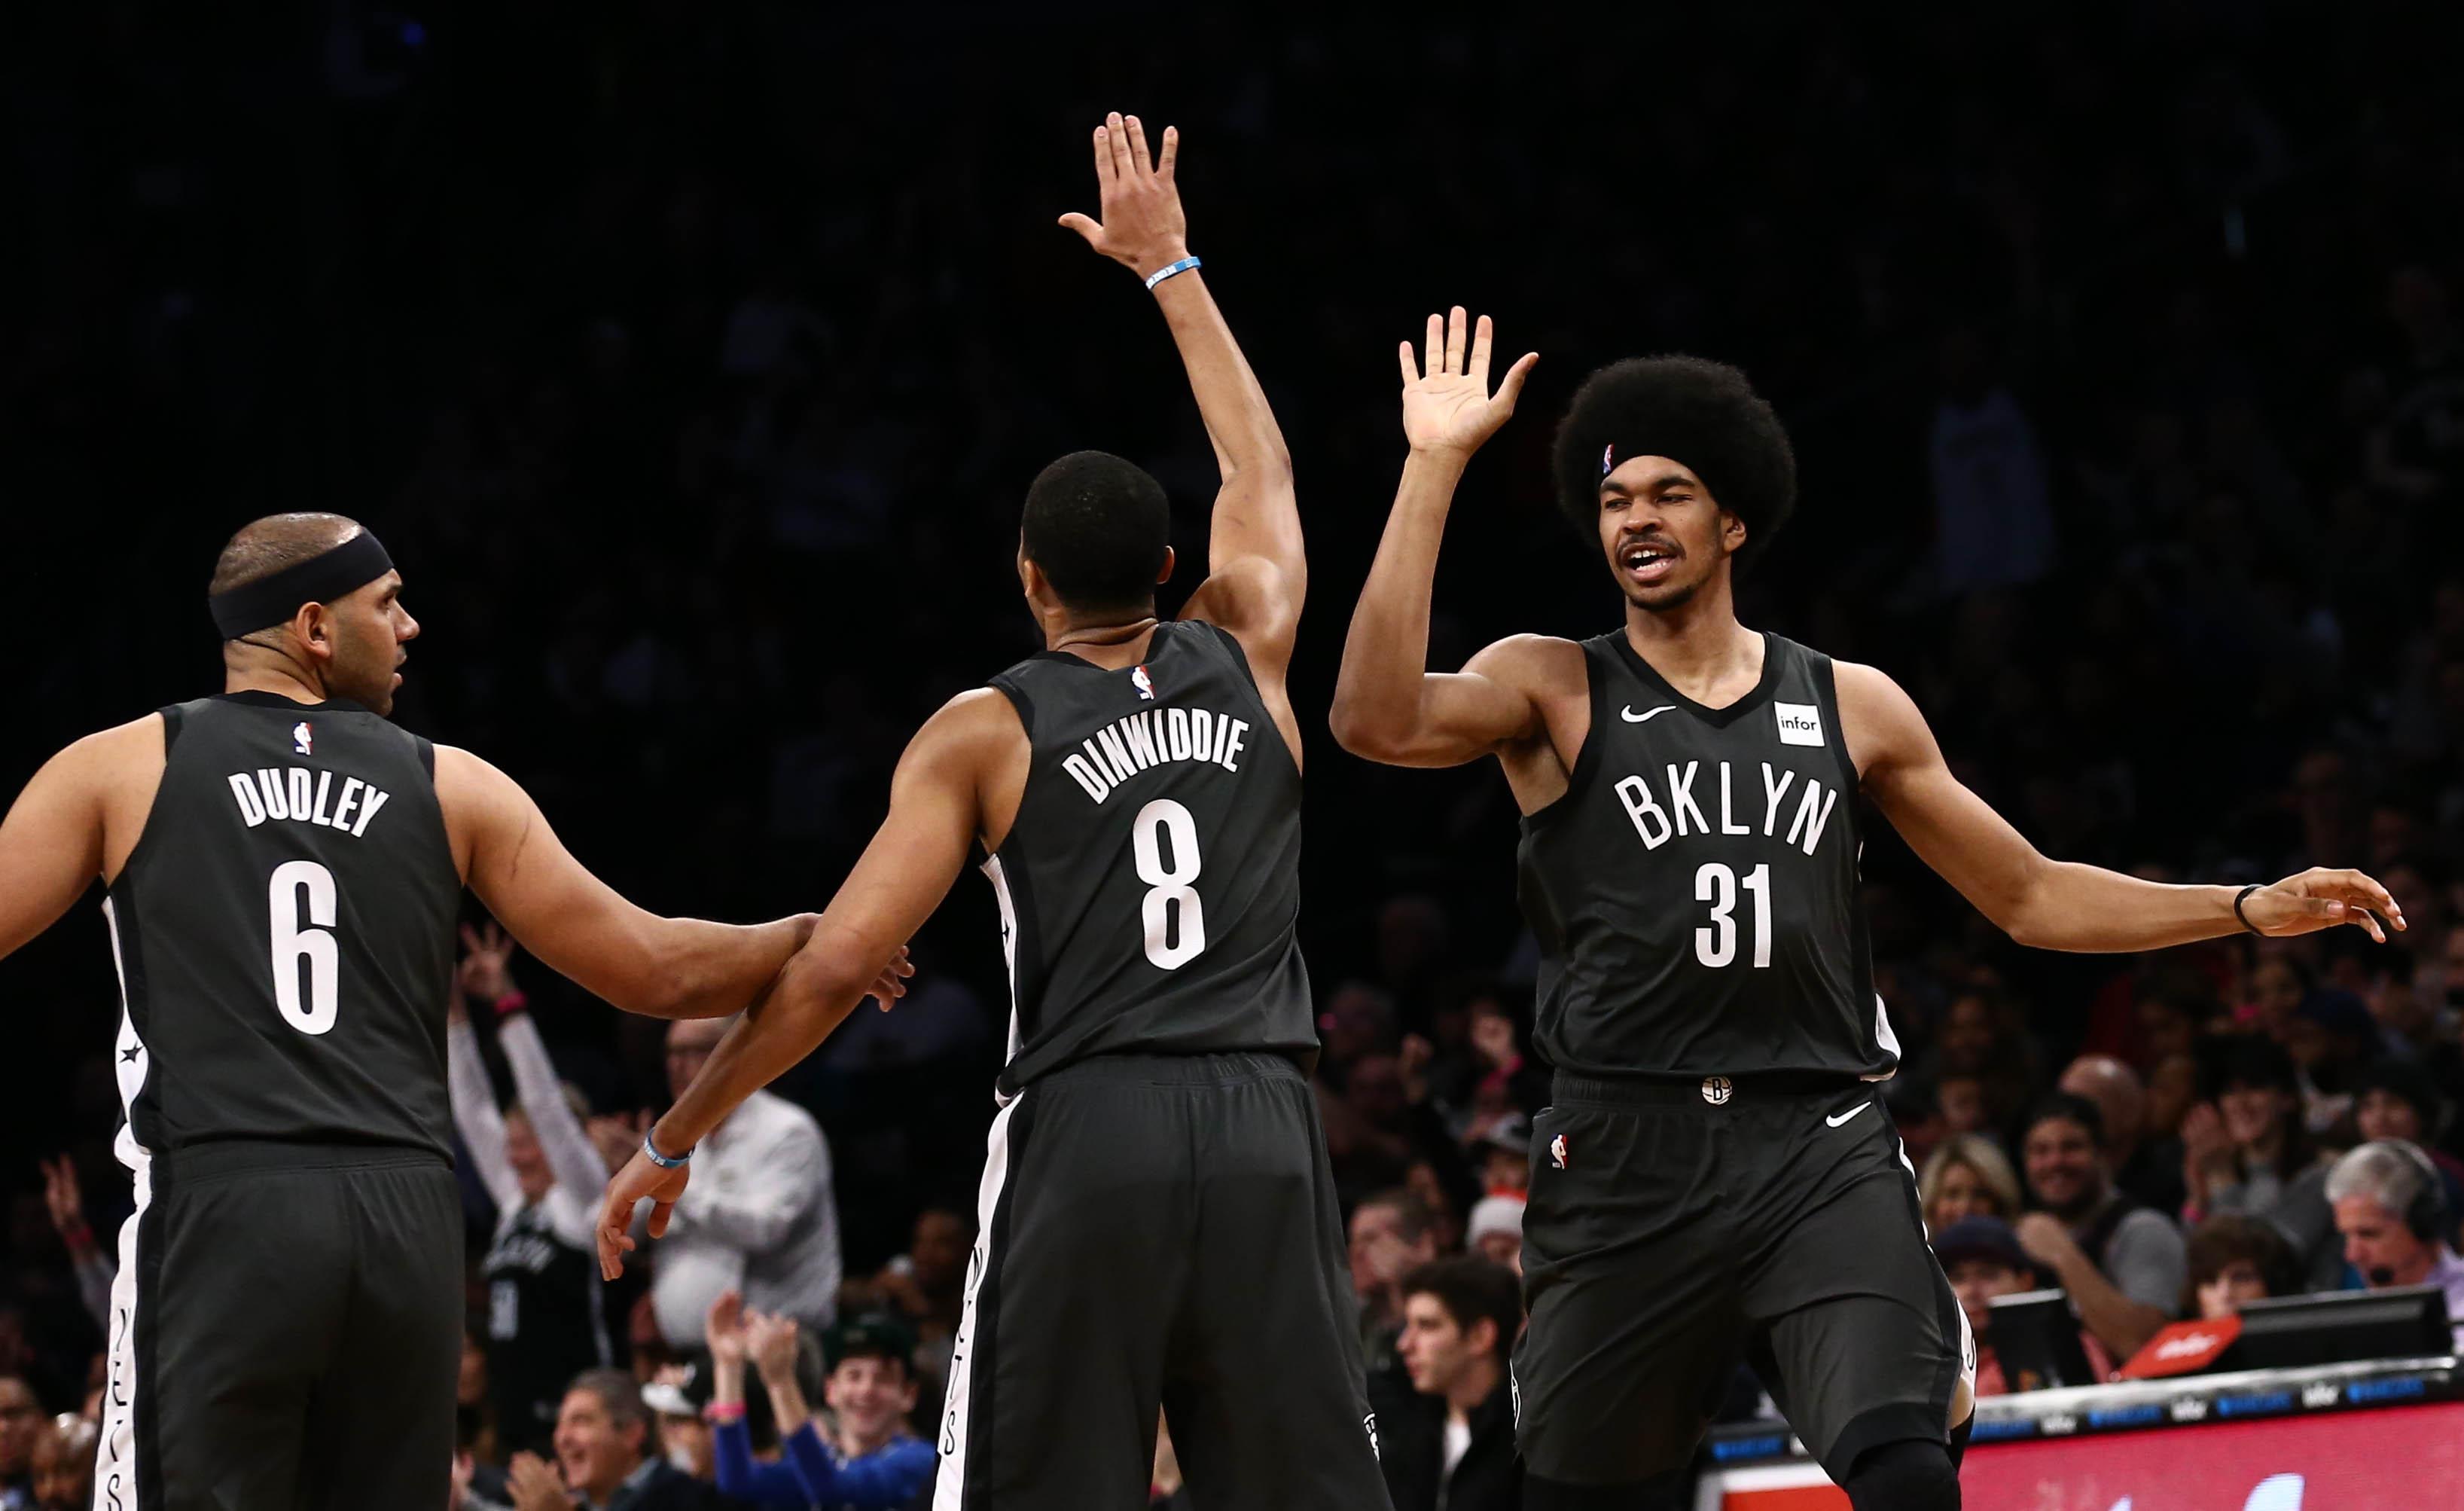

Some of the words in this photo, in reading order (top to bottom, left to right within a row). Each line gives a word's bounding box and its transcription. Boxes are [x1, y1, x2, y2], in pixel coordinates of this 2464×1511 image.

[1061, 708, 1250, 804] DINWIDDIE
[1780, 716, 1816, 731] infor
[227, 767, 390, 838] DUDLEY
[1614, 760, 1837, 856] BKLYN
[1133, 798, 1206, 970] 8
[1695, 862, 1772, 969] 31
[269, 859, 339, 1036] 6
[1712, 1078, 1724, 1101] B
